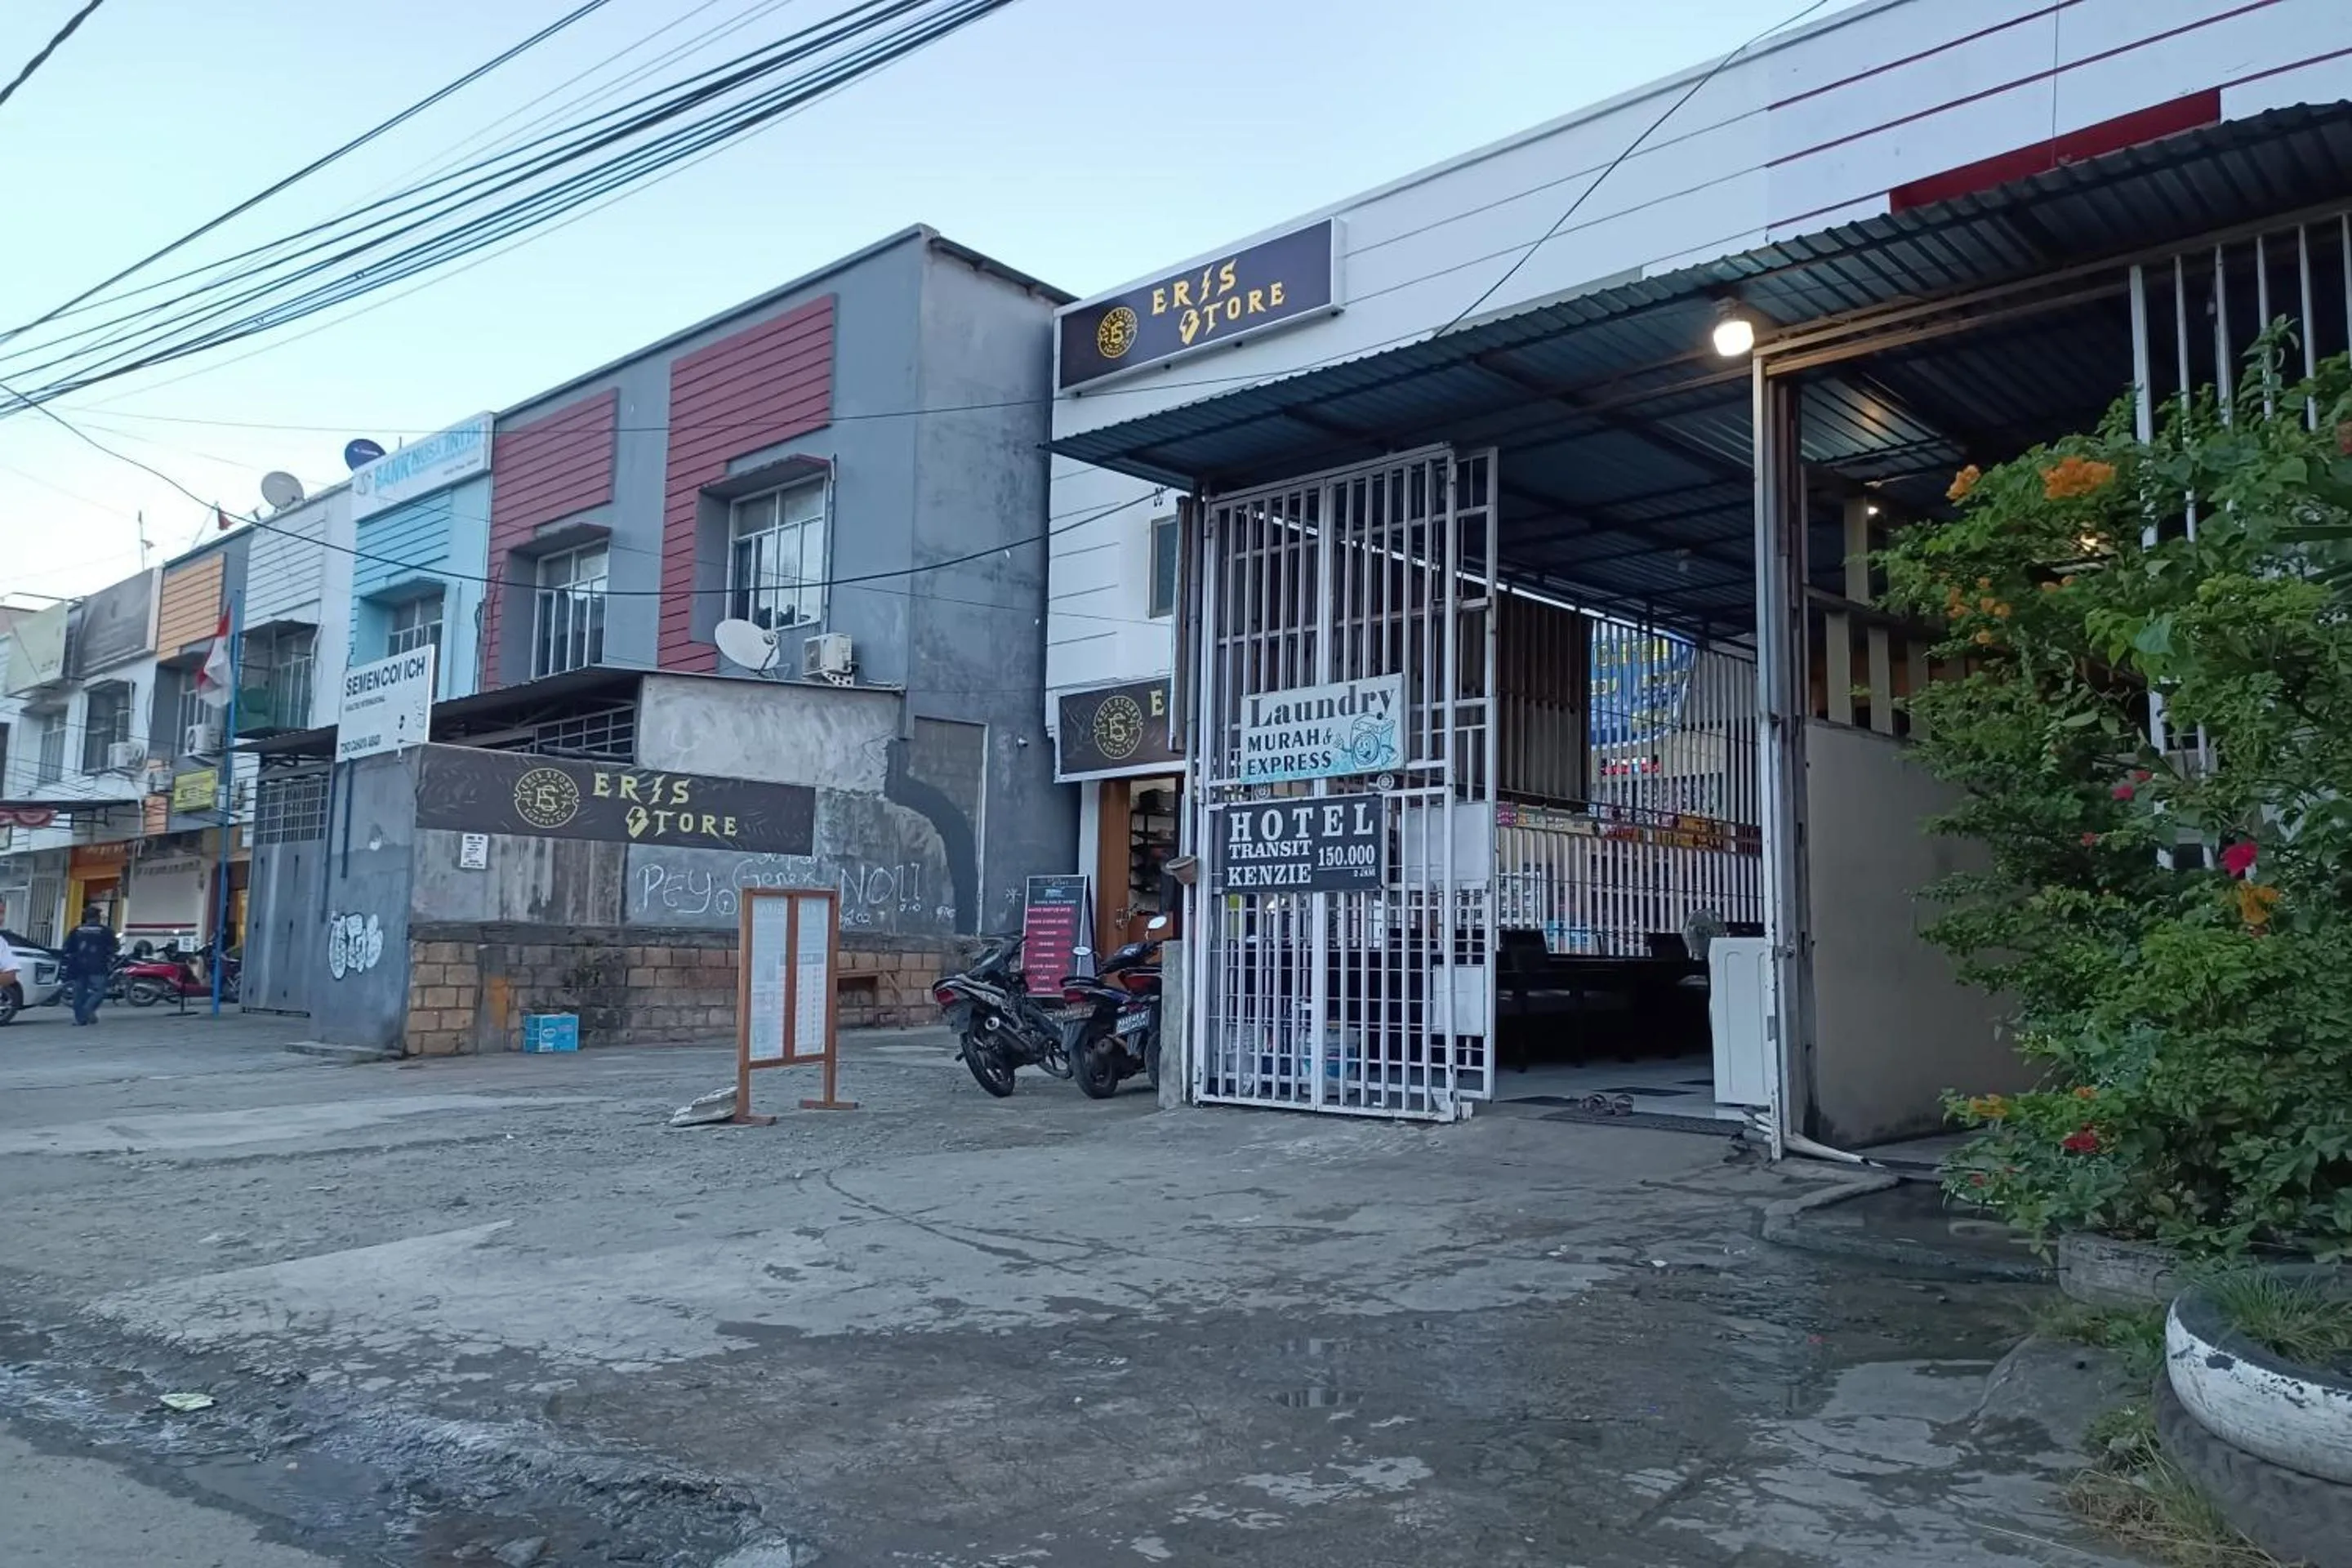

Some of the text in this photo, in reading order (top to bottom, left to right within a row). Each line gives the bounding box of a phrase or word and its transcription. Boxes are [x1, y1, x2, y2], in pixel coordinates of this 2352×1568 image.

[1152, 258, 1238, 316] ERIS
[1249, 684, 1395, 727] Laundry
[1248, 728, 1332, 753] MURAH &
[1247, 750, 1332, 776] EXPRESS
[593, 772, 692, 806] ERIS
[1229, 803, 1374, 843] HOTEL
[1229, 840, 1312, 859] TRANSIT
[1318, 844, 1375, 866] 150.000
[1227, 862, 1312, 887] KENZIE
